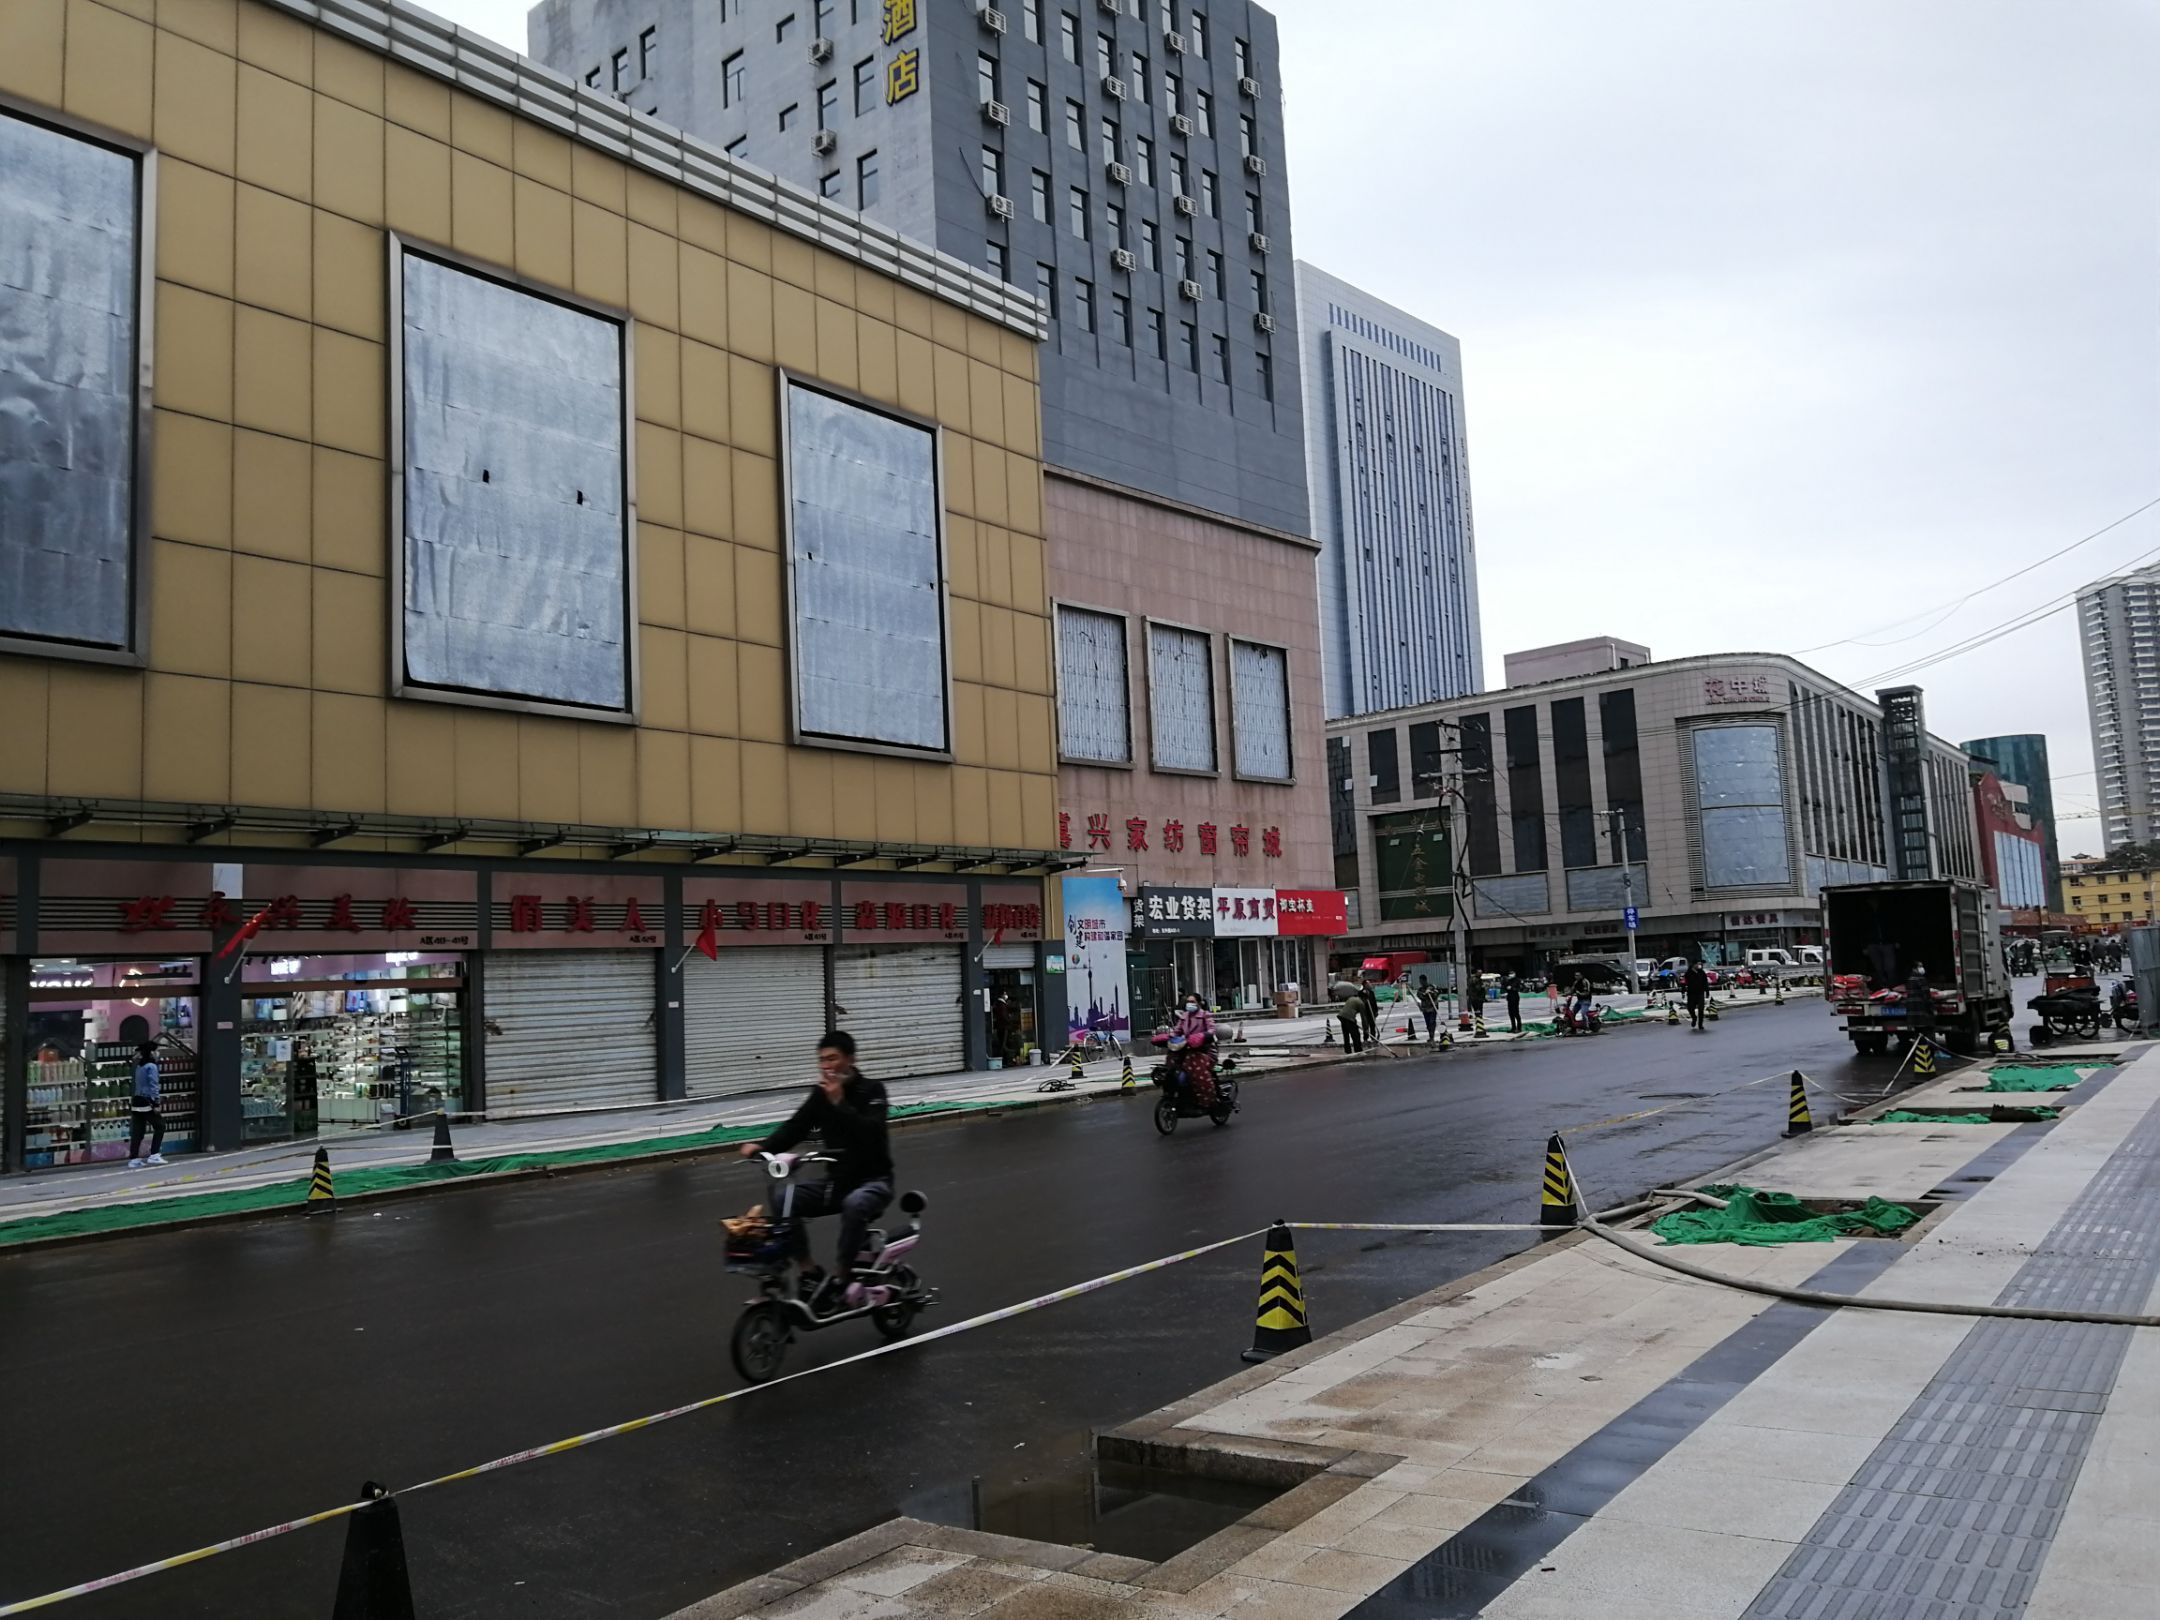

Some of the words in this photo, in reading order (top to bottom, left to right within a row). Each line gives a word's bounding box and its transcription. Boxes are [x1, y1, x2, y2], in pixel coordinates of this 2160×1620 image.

[1133, 899, 1145, 928] 货架
[1149, 895, 1211, 920] 宏业货架
[1077, 919, 1106, 929] 文明城市
[1627, 908, 1636, 928] 停车场
[1084, 931, 1123, 941] 构建和谐家园
